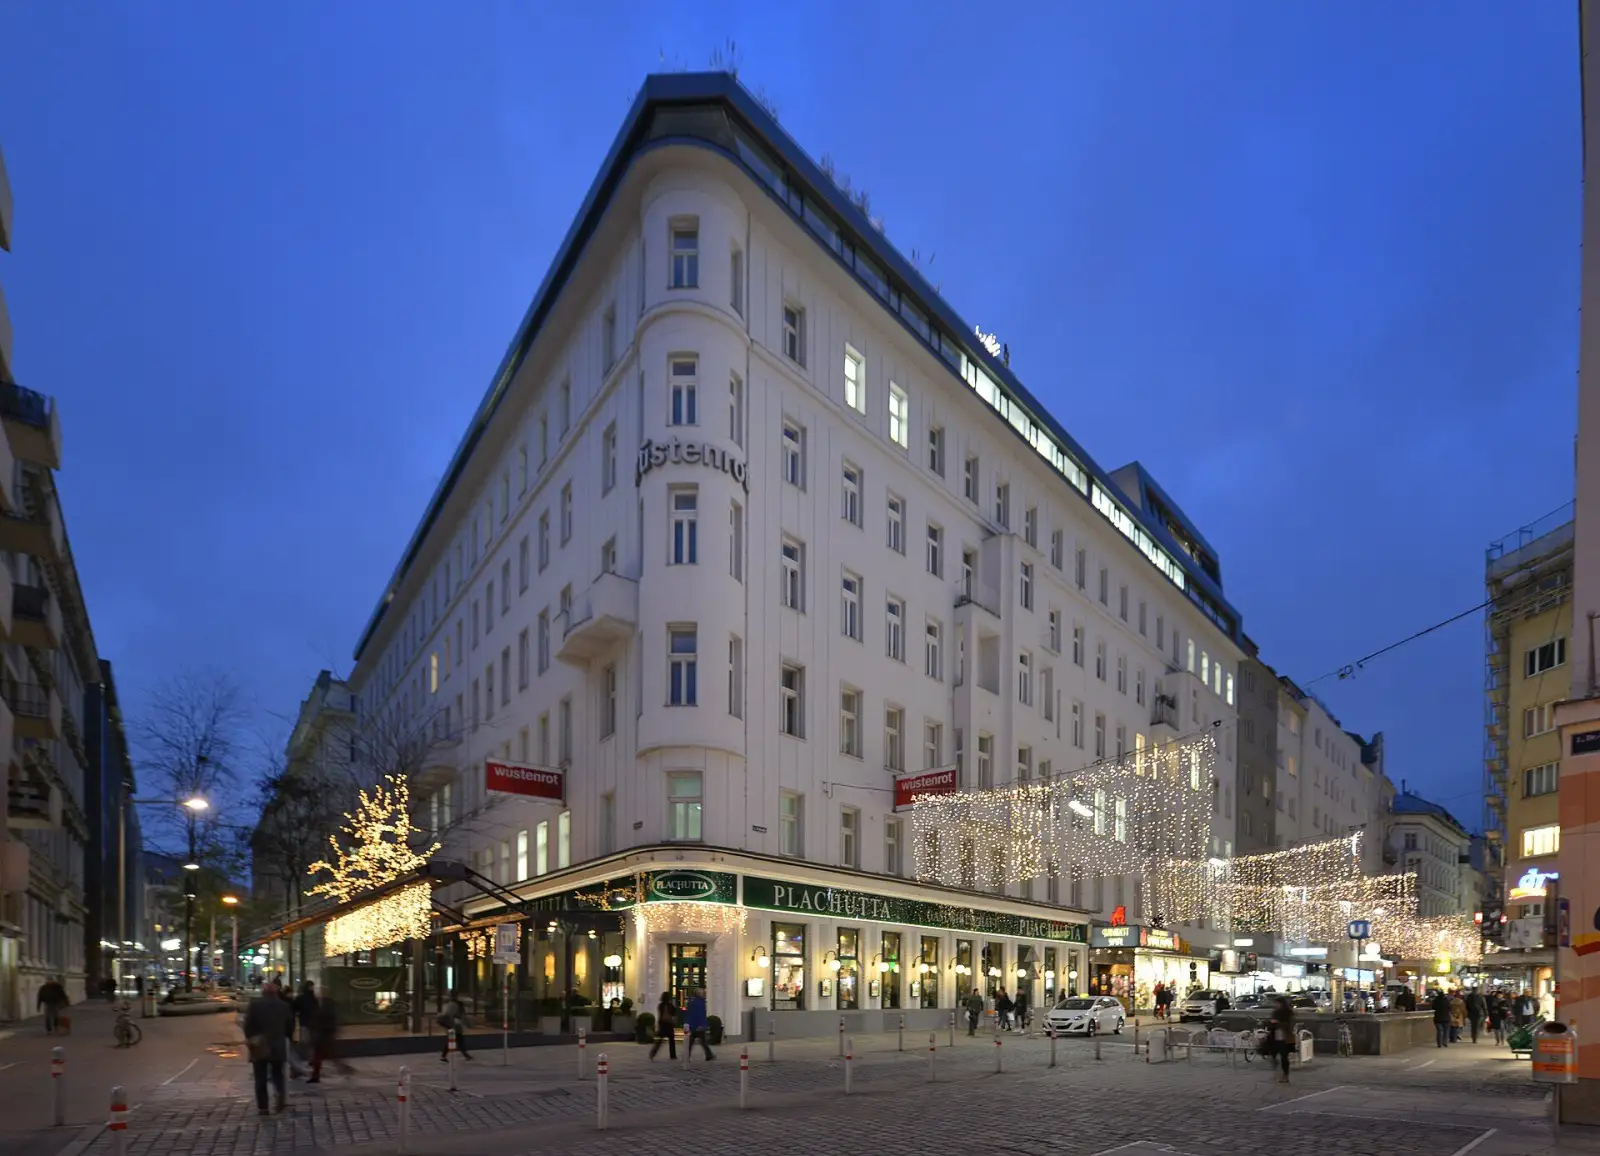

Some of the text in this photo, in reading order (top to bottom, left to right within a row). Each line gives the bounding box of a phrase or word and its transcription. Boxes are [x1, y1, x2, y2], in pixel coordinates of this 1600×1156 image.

[636, 437, 749, 494] üstenro
[656, 880, 708, 890] PLACHUTTA
[773, 885, 890, 918] PLACHUTTA
